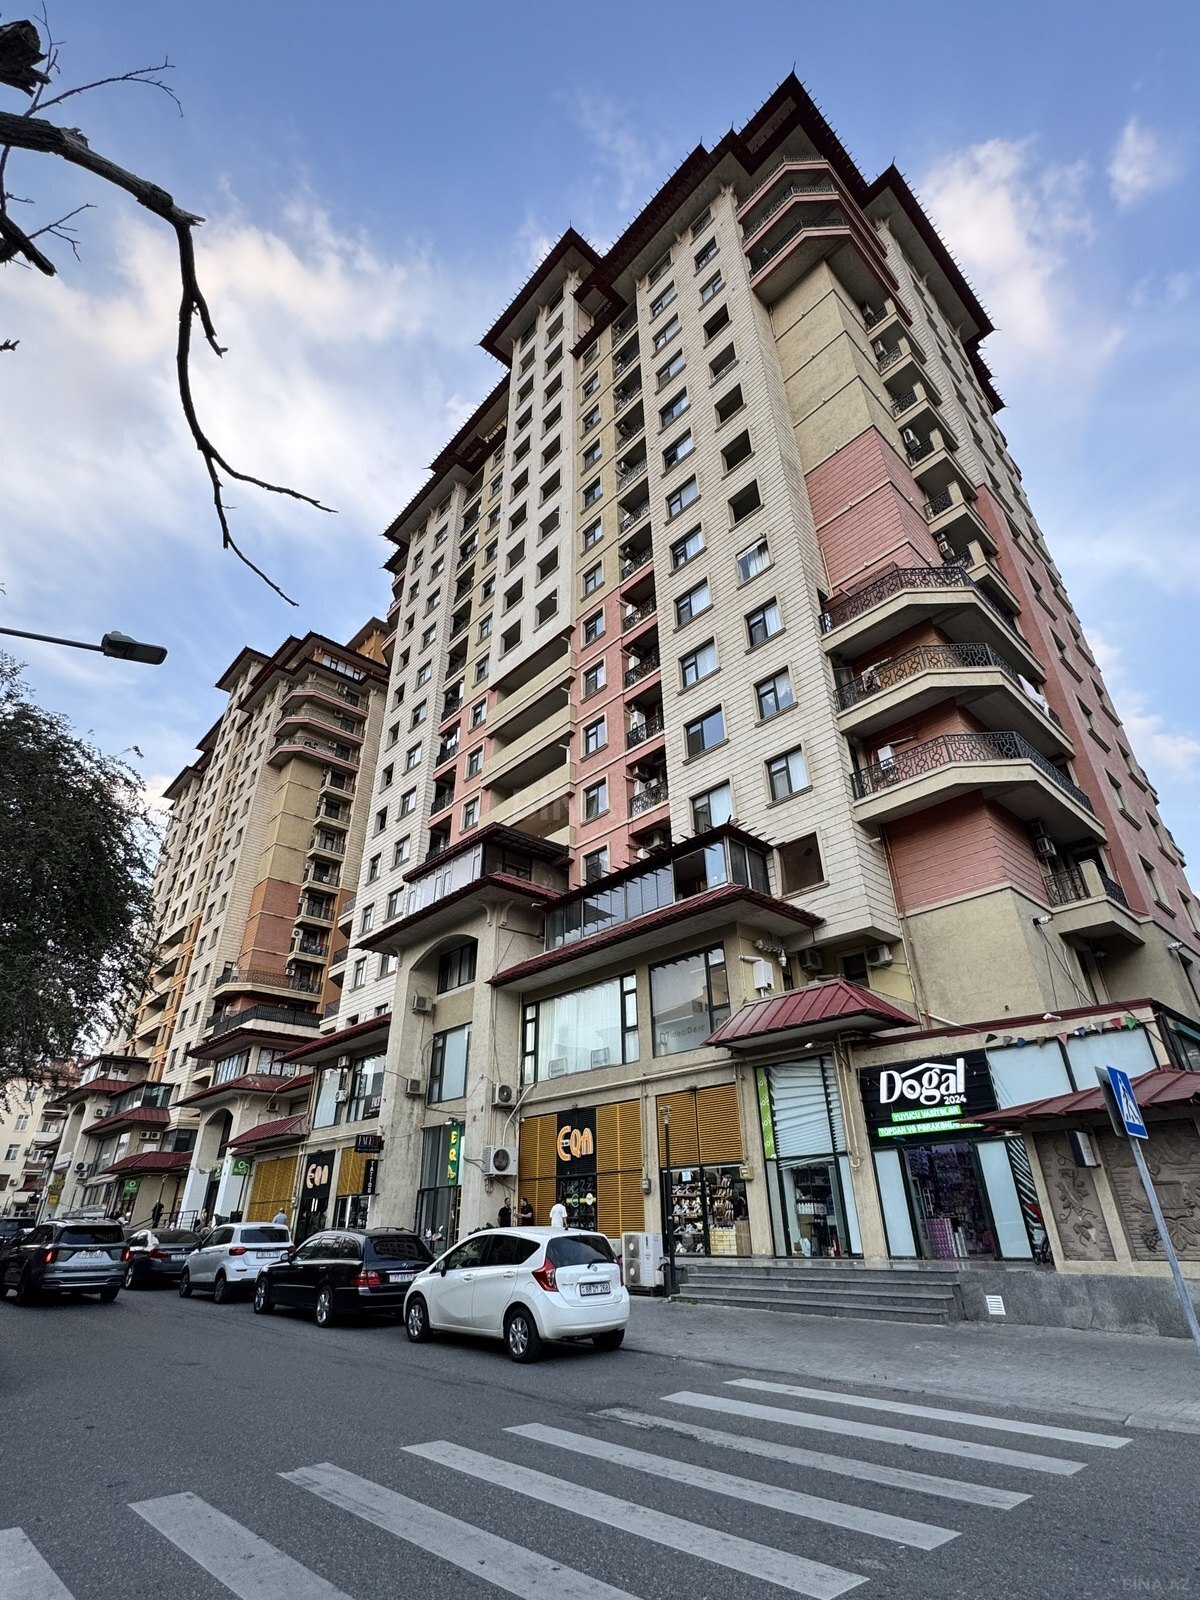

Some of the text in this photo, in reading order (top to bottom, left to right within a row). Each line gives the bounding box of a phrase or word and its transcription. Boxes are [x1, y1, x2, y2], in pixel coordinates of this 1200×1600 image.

[943, 1094, 967, 1105] 2024
[447, 1130, 458, 1180] EQA
[367, 1160, 375, 1193] TATTOO
